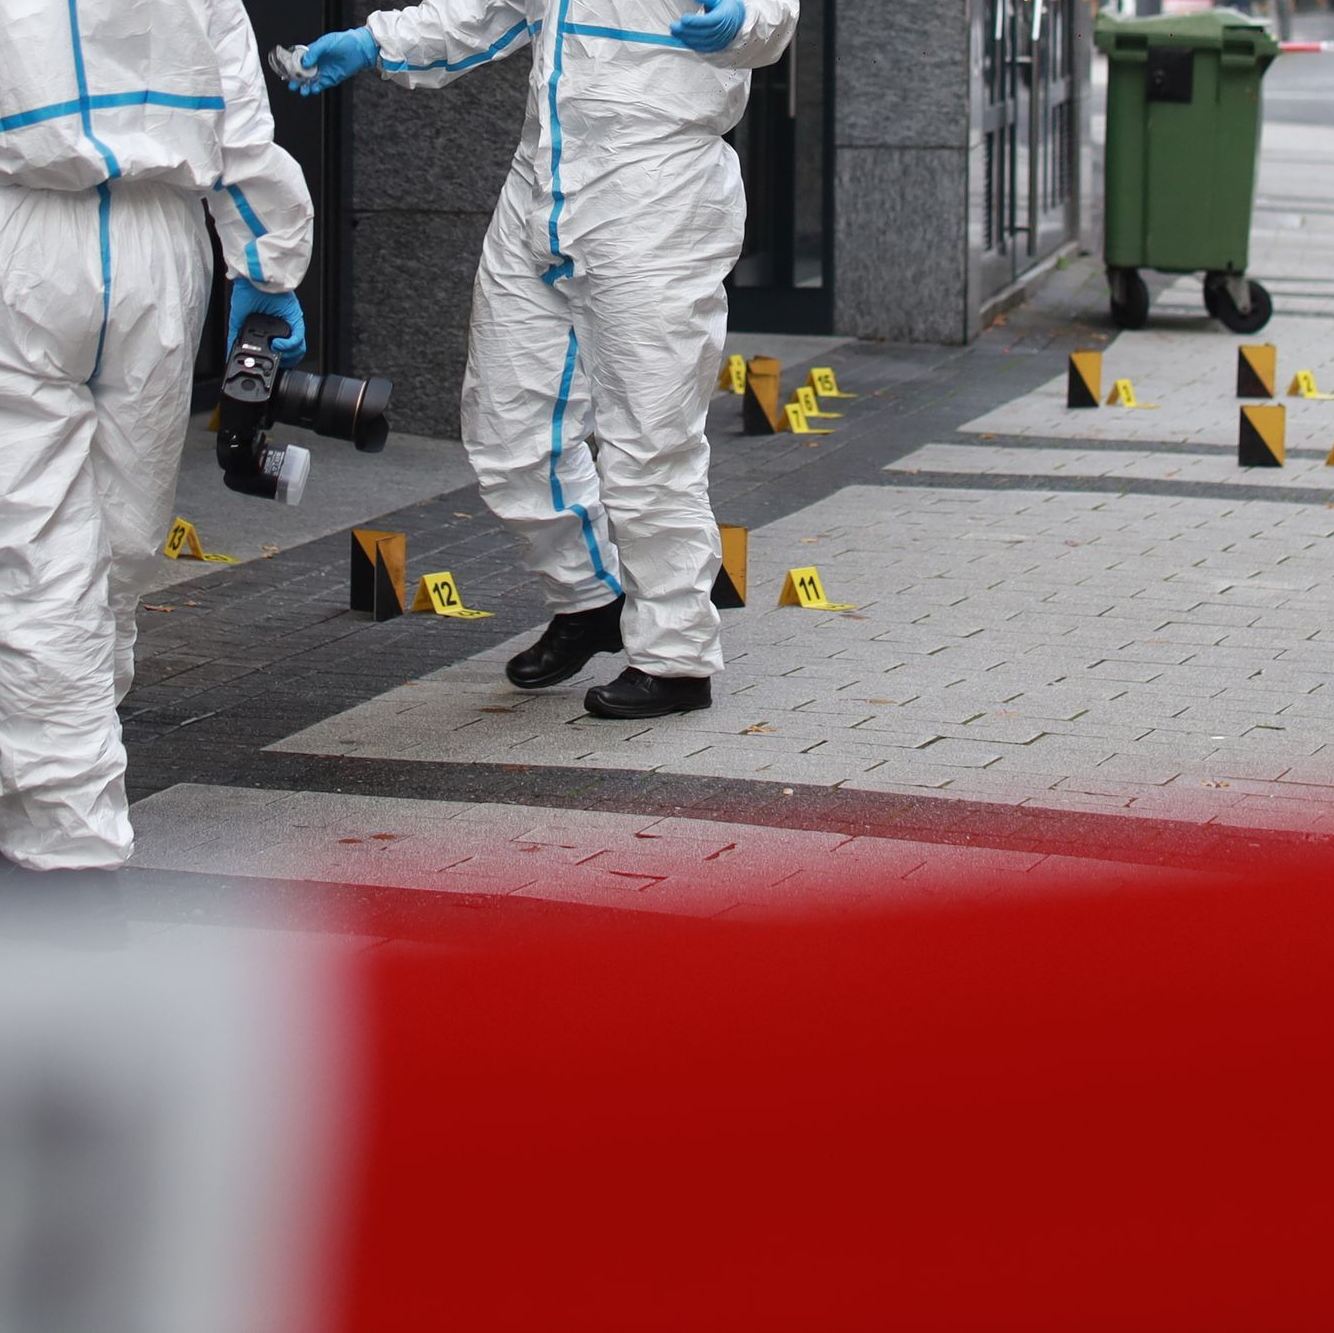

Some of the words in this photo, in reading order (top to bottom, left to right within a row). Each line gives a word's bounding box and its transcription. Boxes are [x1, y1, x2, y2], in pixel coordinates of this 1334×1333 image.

[168, 525, 185, 551] 13
[433, 581, 457, 607] 12
[799, 575, 821, 601] 11
